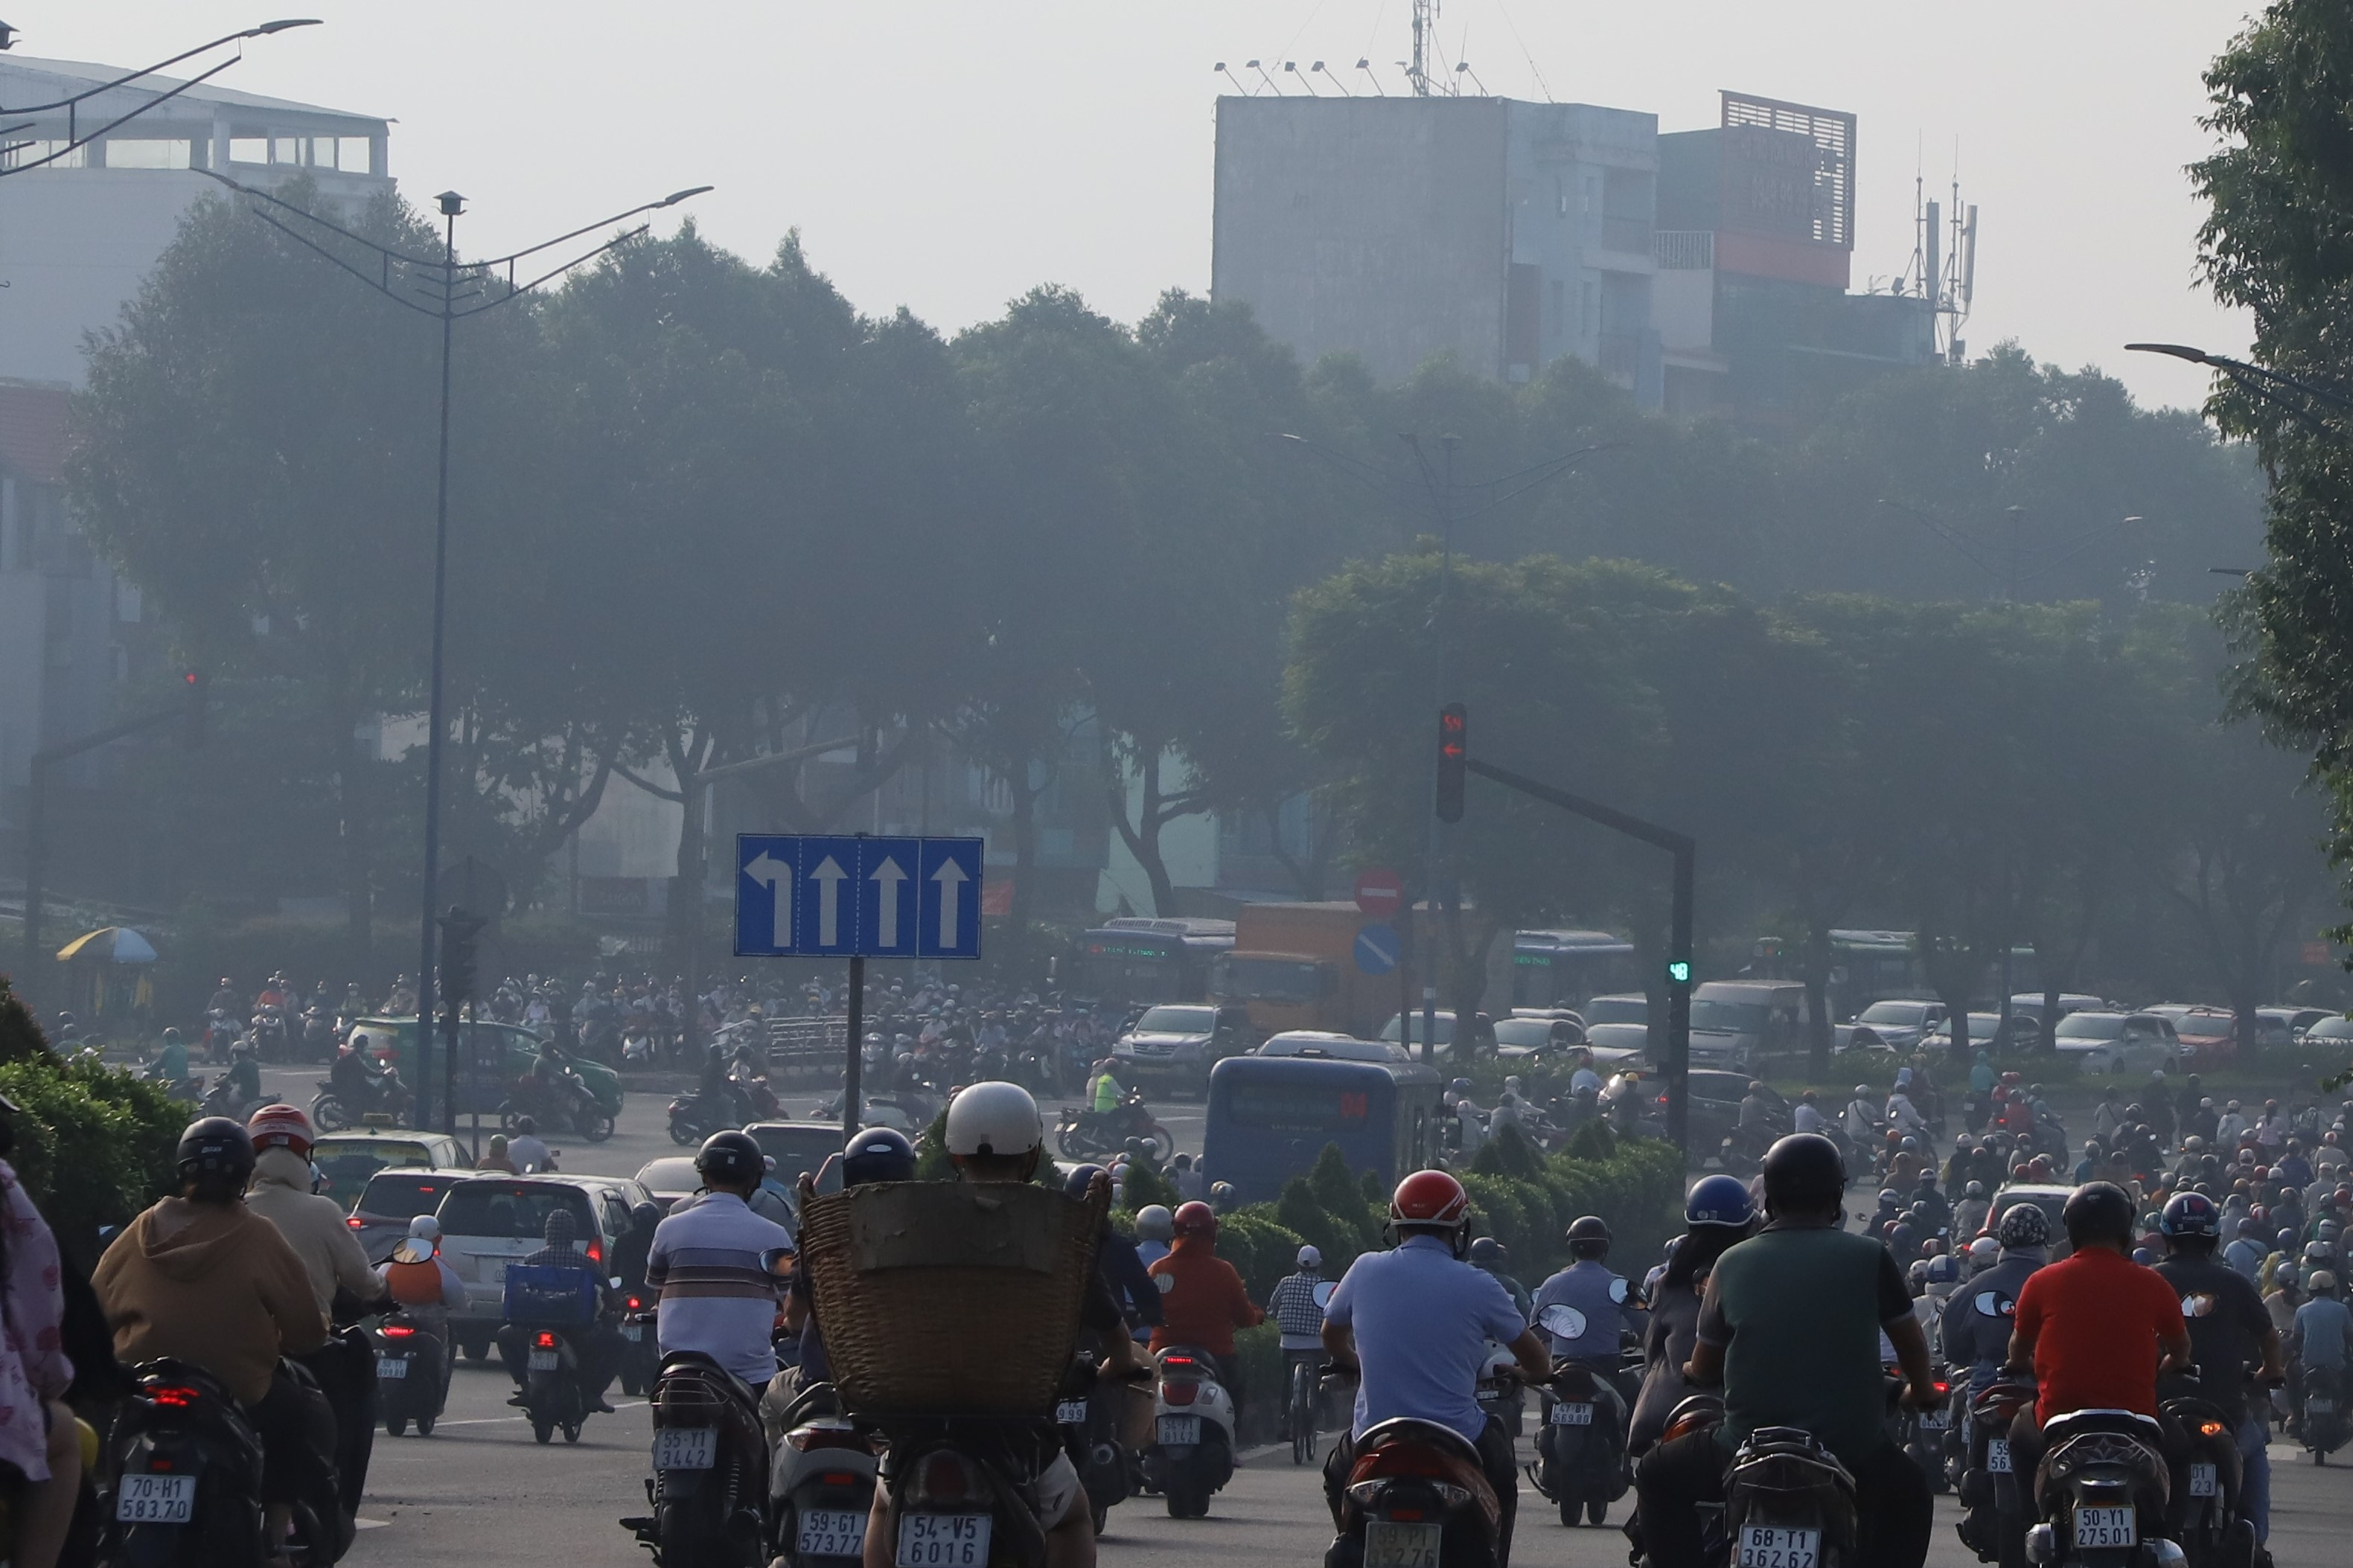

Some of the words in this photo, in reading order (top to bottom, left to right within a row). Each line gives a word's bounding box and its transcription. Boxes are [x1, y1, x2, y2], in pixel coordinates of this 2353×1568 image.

[1670, 962, 1688, 980] 48
[664, 1432, 706, 1449] 55-Y1
[662, 1449, 706, 1468] 3442
[1991, 1456, 2012, 1469] 56
[133, 1479, 181, 1499] 70-H1
[122, 1499, 188, 1520] 583.70
[2083, 1510, 2125, 1526] 50-Y1
[810, 1513, 856, 1532] 59-G1
[914, 1517, 977, 1539] 54-V5
[800, 1533, 862, 1554] 573.77
[1753, 1529, 1807, 1549] 68-T1
[2078, 1527, 2130, 1546] 275.01
[910, 1542, 974, 1564] 6016
[1744, 1549, 1813, 1567] 362.62
